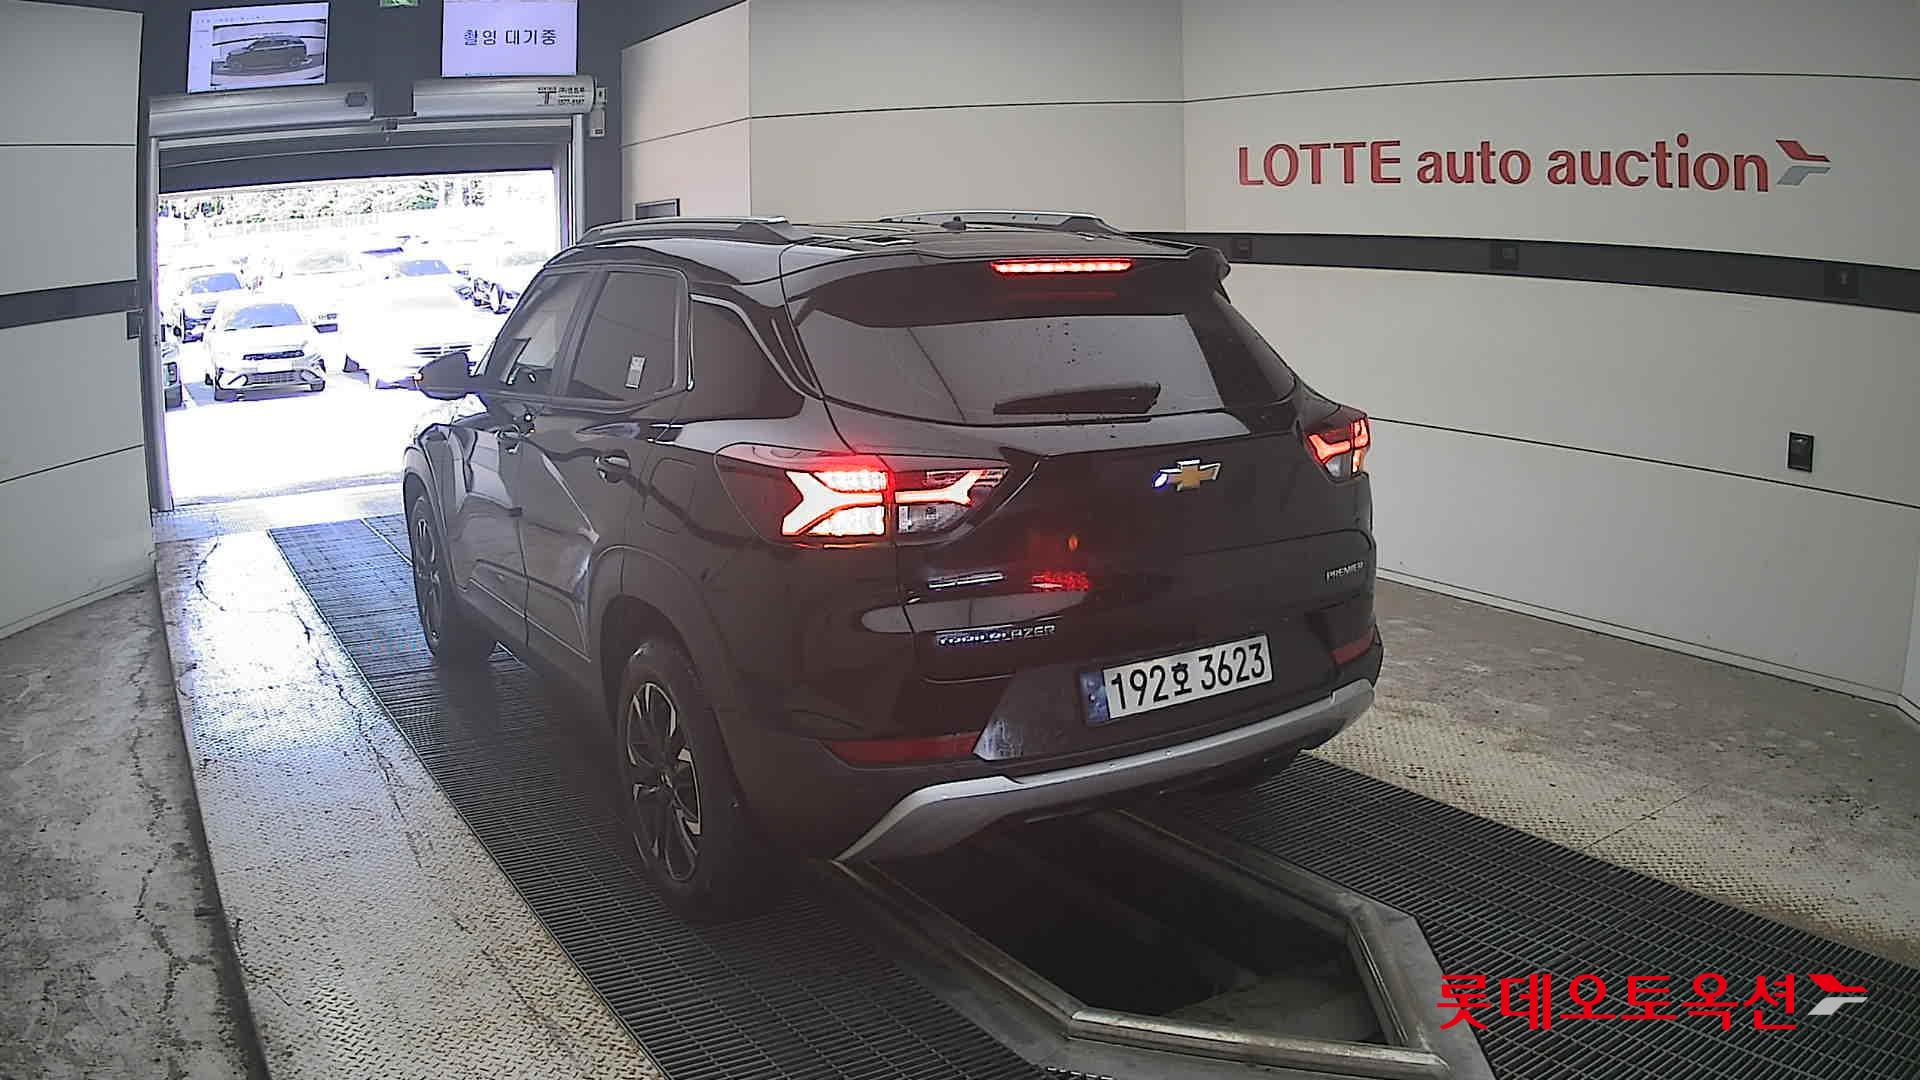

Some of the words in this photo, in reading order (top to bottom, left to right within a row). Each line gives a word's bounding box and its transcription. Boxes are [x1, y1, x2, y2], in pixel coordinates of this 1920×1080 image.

[505, 28, 558, 46] 대기중
[1239, 140, 1401, 187] LOTTE
[1417, 141, 1532, 185] auto
[1547, 132, 1769, 192] auction
[1326, 560, 1364, 580] PREMIER
[1111, 661, 1193, 710] 192호
[1198, 642, 1265, 691] 3623
